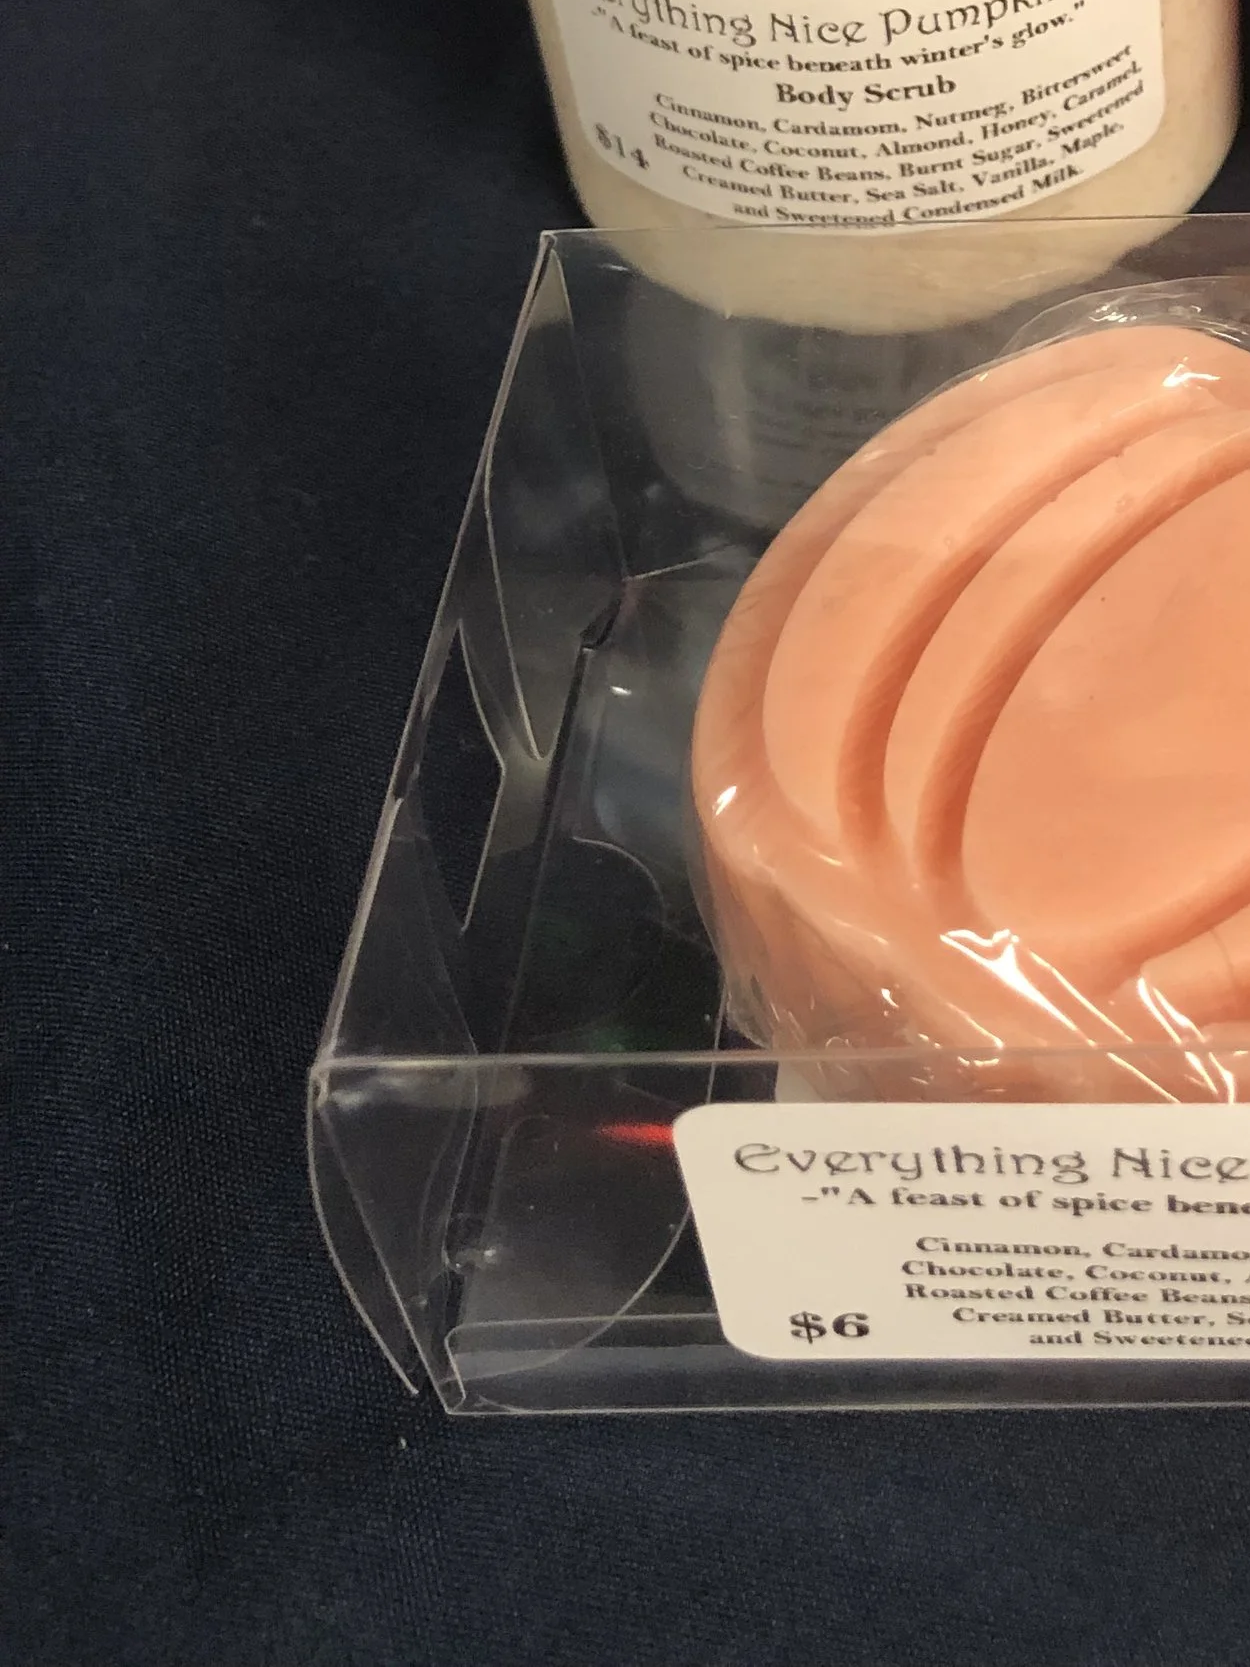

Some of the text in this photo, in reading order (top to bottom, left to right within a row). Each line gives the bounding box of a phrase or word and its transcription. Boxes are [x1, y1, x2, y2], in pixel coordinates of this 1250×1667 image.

[629, 22, 681, 53] feast
[688, 45, 713, 60] of
[719, 52, 781, 72] spice
[787, 54, 892, 72] beneath
[900, 34, 1004, 66] winter's
[1011, 0, 1085, 49] glow."
[770, 12, 867, 47] Nice
[655, 45, 1131, 136] Cinnamon, Cardamom, Nutmeg, Bittersweet
[775, 74, 957, 111] Body Scrub
[650, 112, 757, 152] Chocolate,
[763, 140, 867, 158] Coconut,
[875, 131, 973, 157] Almond,
[654, 80, 1144, 181] Roasted Coffee Beans, Burnt Sugar, Sweetened
[683, 165, 773, 198] Creamed
[780, 184, 860, 204] Butter,
[866, 187, 906, 203] Sea
[912, 180, 964, 198] Salt,
[972, 157, 1054, 186] Vanilla,
[732, 203, 769, 218] and
[903, 185, 1025, 219] Condensed
[734, 1143, 1089, 1184] Everything
[1111, 1147, 1250, 1183] Nice
[801, 1186, 876, 1205] -"A
[890, 1187, 985, 1207] feast
[999, 1190, 1043, 1208] of
[1052, 1192, 1152, 1217] spice
[916, 1237, 1091, 1257] Cinnamon,
[901, 1260, 1075, 1280] Chocolate,
[1085, 1265, 1231, 1284] Coconut,
[904, 1283, 1035, 1300] Roasted
[1046, 1286, 1148, 1302] Coffee
[789, 1310, 871, 1344] $6
[952, 1307, 1091, 1324] Creamed
[1104, 1309, 1215, 1327] Butter,
[1029, 1330, 1083, 1344] and
